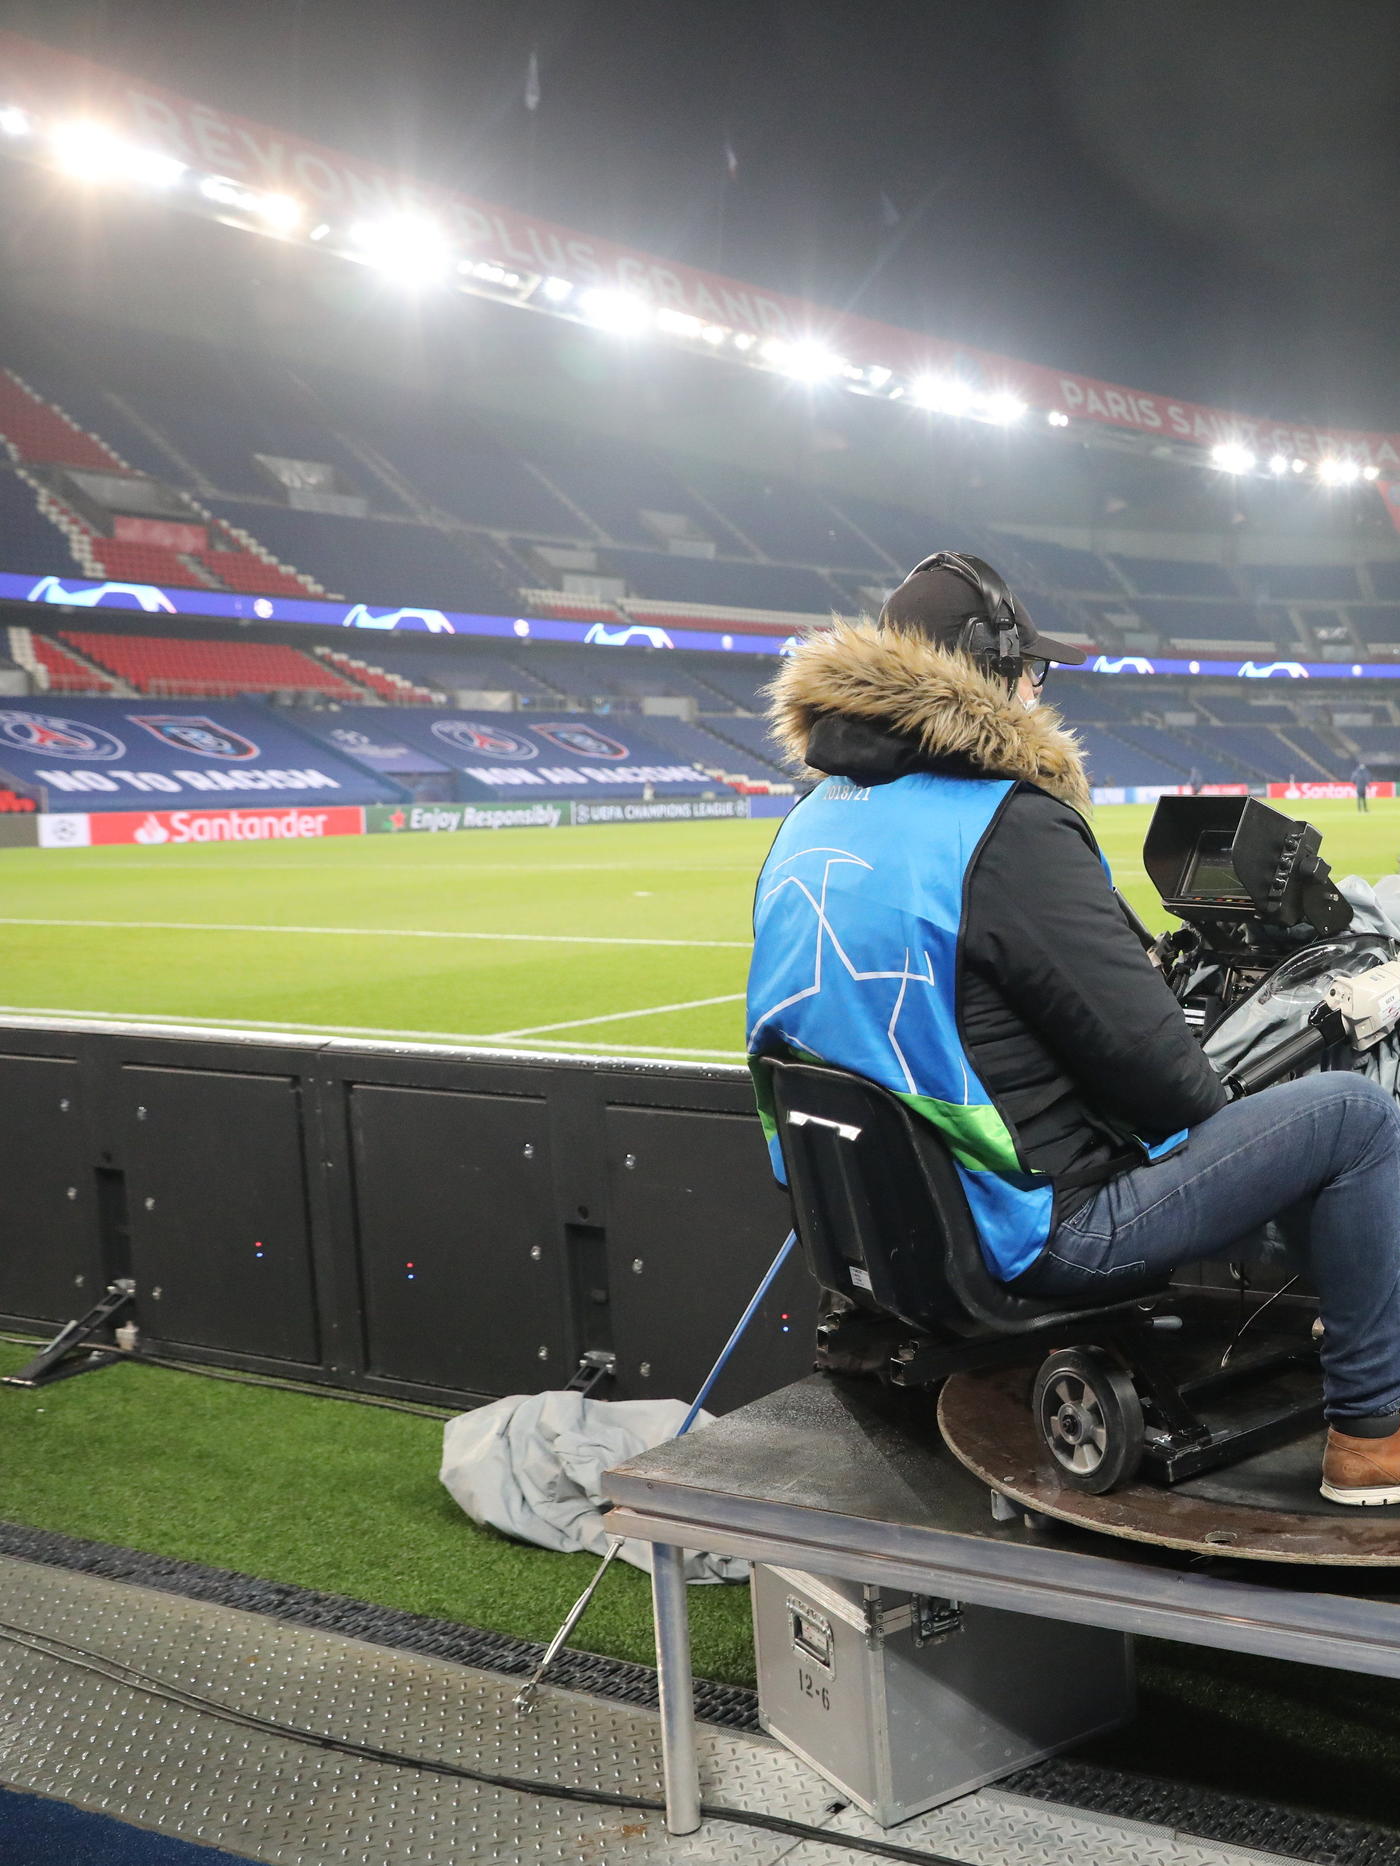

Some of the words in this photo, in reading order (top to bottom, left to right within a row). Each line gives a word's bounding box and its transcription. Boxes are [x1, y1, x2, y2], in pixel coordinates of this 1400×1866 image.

[1059, 379, 1163, 428] PARIS
[35, 769, 120, 792] NO
[107, 769, 182, 793] TO
[172, 768, 341, 792] RACISM
[1301, 782, 1377, 799] Santanr
[410, 809, 460, 830] Enjoy
[463, 804, 561, 828] Responsibly
[591, 806, 624, 820] UEFA
[624, 803, 691, 819] CHAMPIONS
[692, 802, 735, 817] LEAGUE
[169, 811, 328, 843] Santander
[798, 1667, 831, 1711] 12-6
